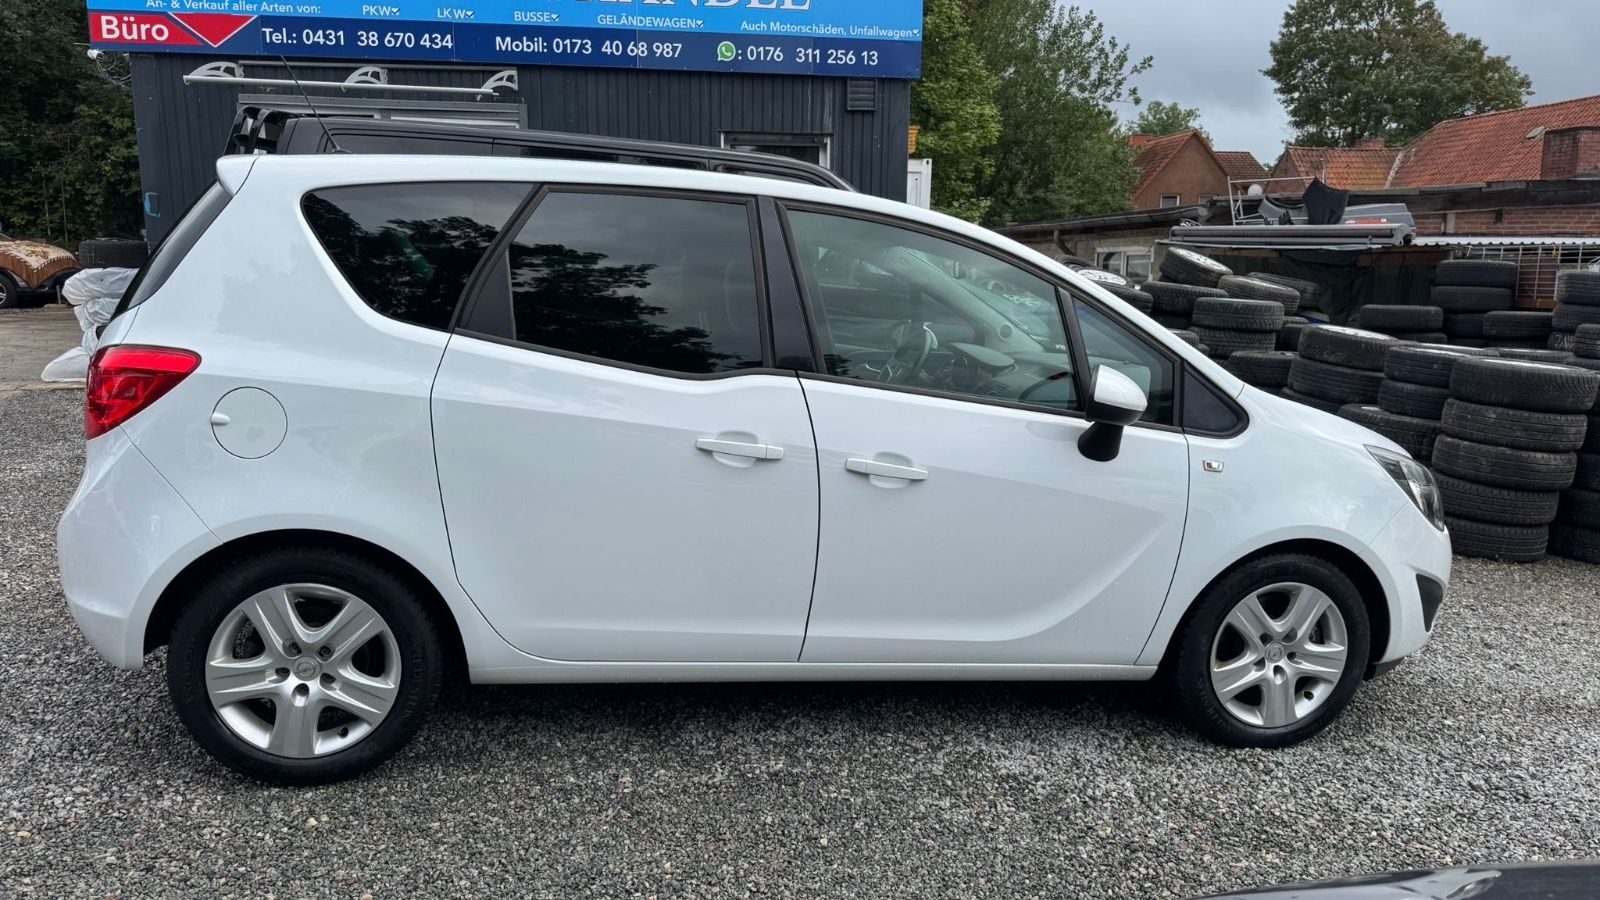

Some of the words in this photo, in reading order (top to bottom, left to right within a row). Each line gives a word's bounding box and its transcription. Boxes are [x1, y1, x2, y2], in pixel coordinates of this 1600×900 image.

[146, 0, 167, 8] An-
[171, 0, 181, 9] &
[185, 0, 229, 10] Verkauf
[232, 1, 258, 11] aller
[260, 2, 293, 13] Arten
[296, 5, 321, 14] von:
[362, 5, 391, 16] PKW
[514, 11, 550, 22] BUSSE
[100, 15, 169, 41] Büro
[597, 13, 696, 28] GELÄNDEWAGEN
[741, 20, 767, 31] Auch
[770, 21, 847, 36] Motorschäden,
[850, 25, 913, 39] Unfallwagen
[262, 28, 297, 44] Tel.:
[302, 29, 344, 45] 0431
[357, 31, 379, 47] 38
[384, 32, 415, 48] 670
[420, 33, 454, 49] 434
[495, 36, 548, 53] Mobil:
[553, 38, 592, 54] 0173
[601, 40, 623, 56] 40
[627, 41, 648, 57] 68
[652, 42, 682, 58] 987
[747, 46, 784, 62] 0176
[795, 47, 820, 63] 311
[827, 49, 857, 65] 256
[861, 50, 879, 66] 13
